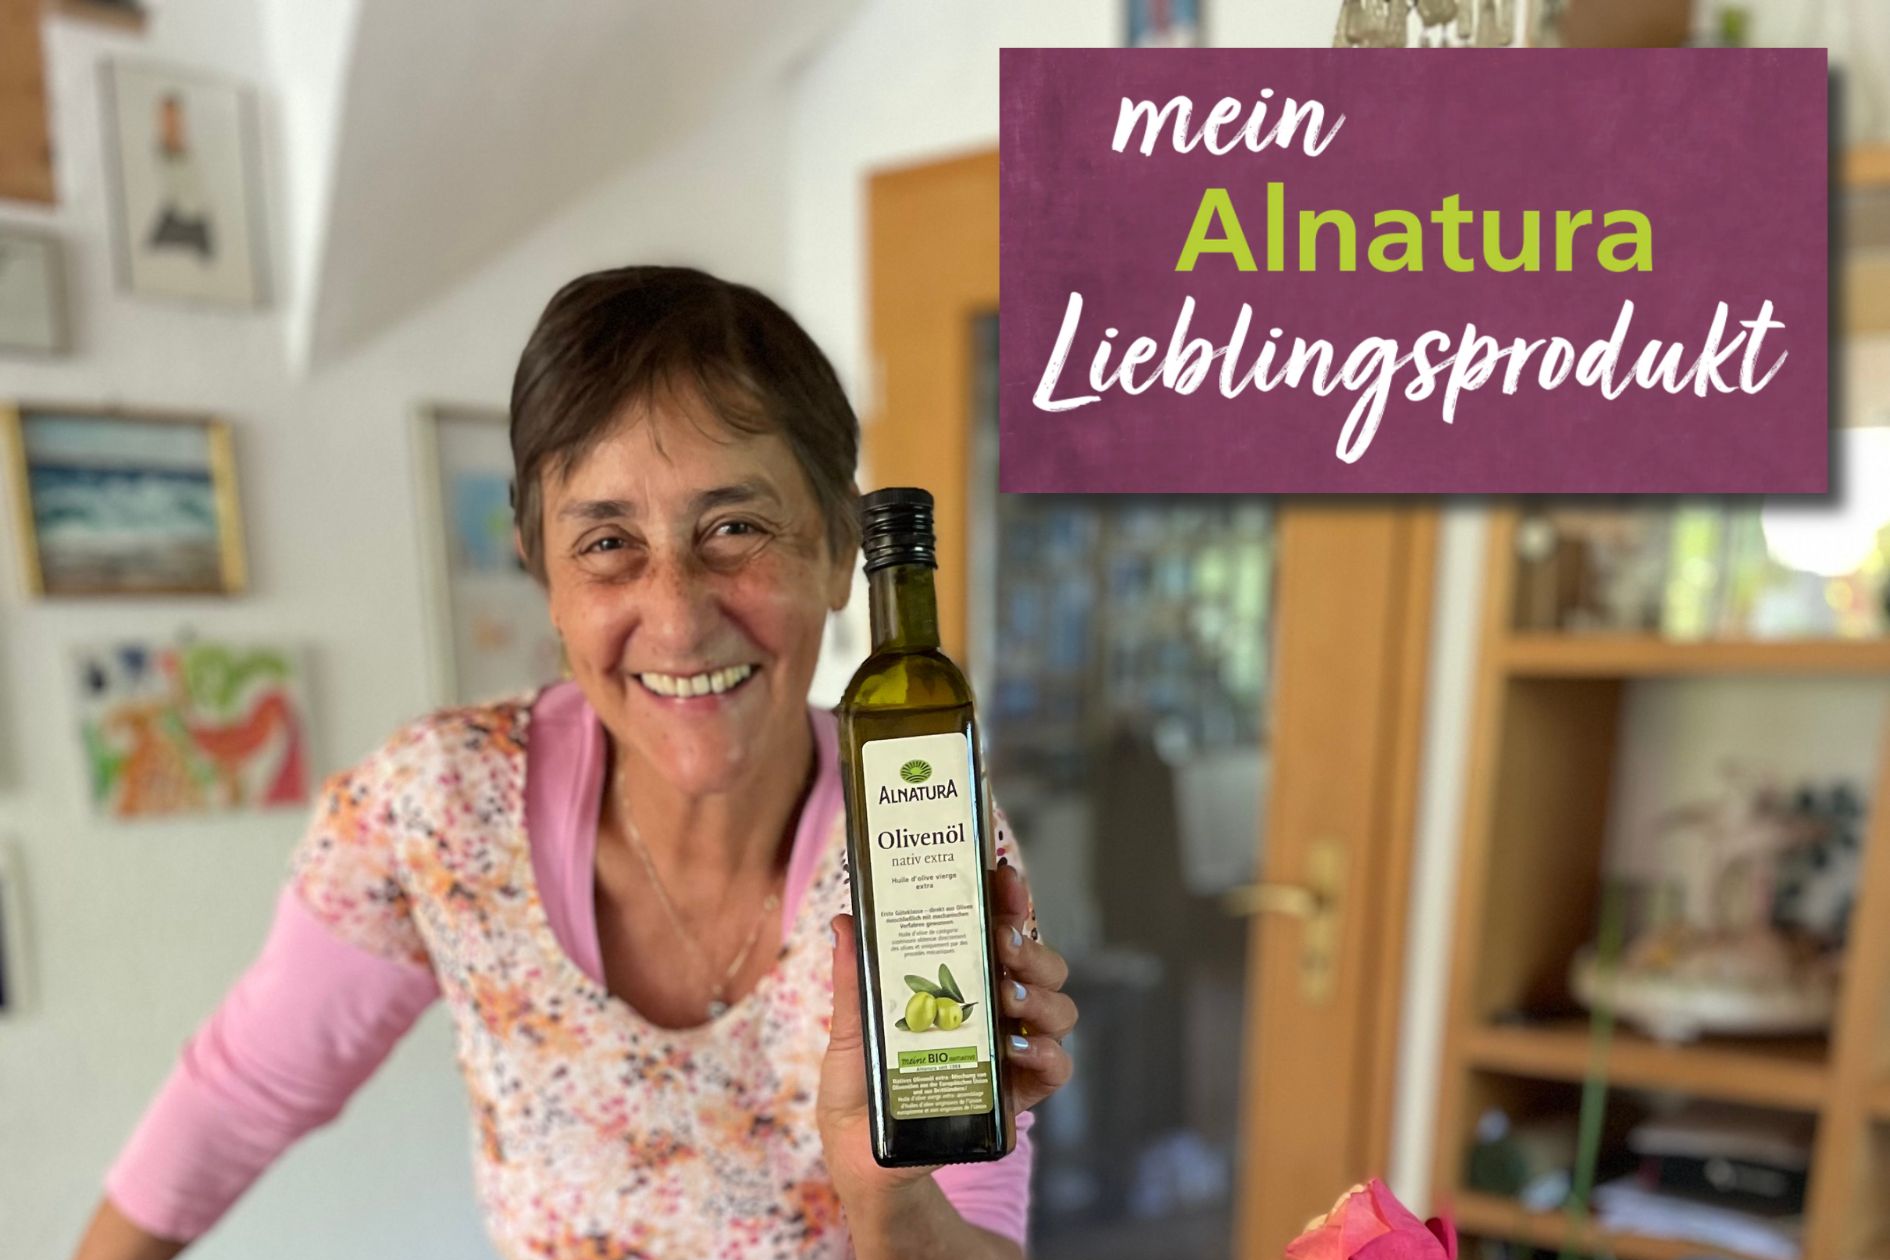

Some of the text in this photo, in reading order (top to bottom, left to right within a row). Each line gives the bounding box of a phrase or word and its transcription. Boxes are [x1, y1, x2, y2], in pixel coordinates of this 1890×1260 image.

[878, 779, 958, 805] ALNATURA
[877, 822, 965, 850] Olivenöl
[891, 853, 955, 867] nativ extra
[935, 872, 957, 880] vierge
[928, 1053, 948, 1063] BIO
